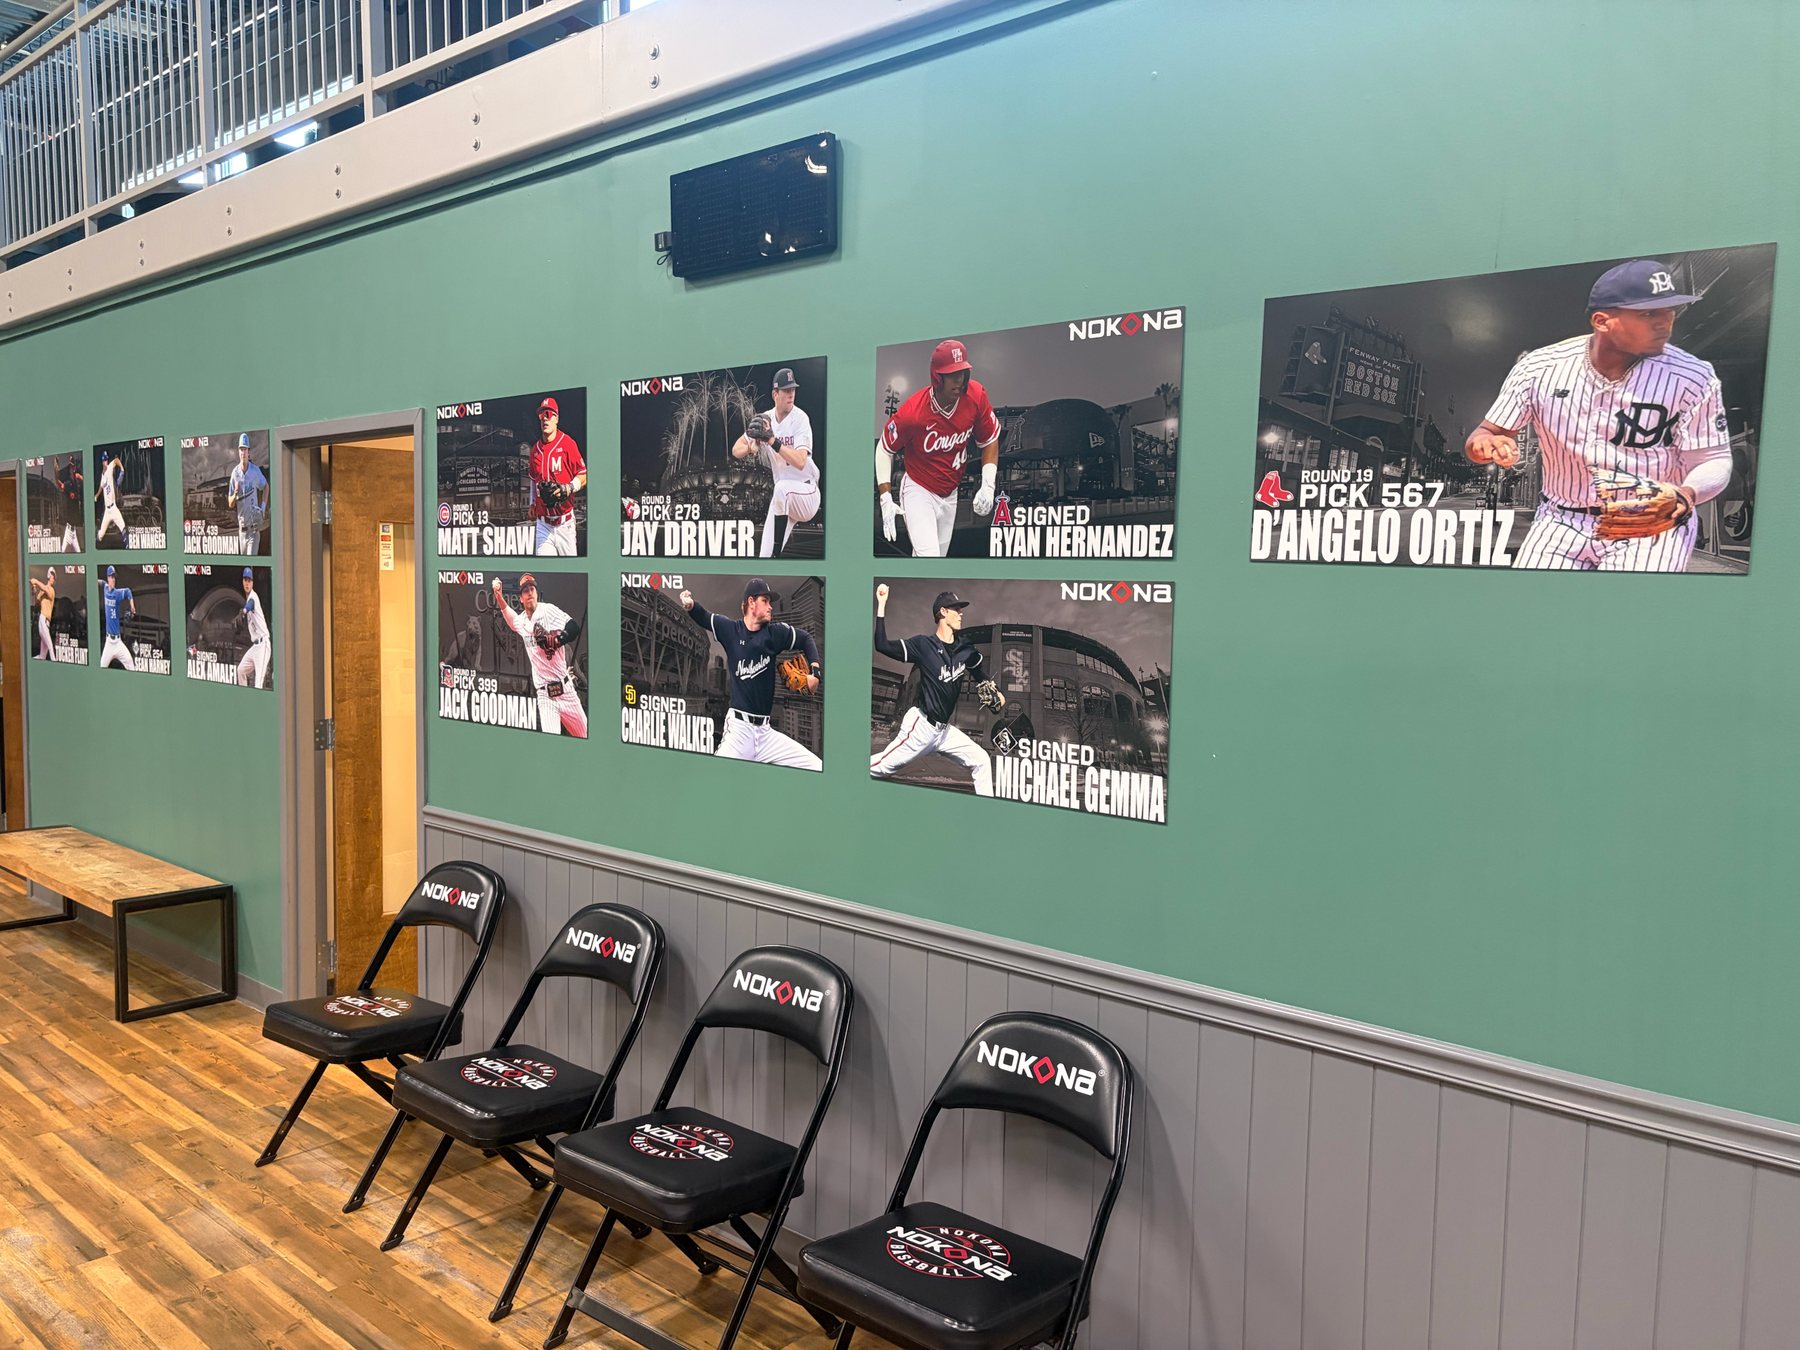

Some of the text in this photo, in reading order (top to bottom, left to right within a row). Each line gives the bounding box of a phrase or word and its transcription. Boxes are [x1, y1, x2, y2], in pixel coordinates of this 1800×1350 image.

[1069, 309, 1183, 341] NOKONA
[1349, 347, 1401, 371] FENWAY PARK
[621, 376, 683, 396] NOKONA
[1347, 362, 1399, 391] BOSTON
[1344, 378, 1397, 405] RED SOX
[437, 402, 482, 420] NOKONA
[1301, 469, 1373, 483] ROUND 19
[642, 496, 664, 504] ROUND
[1299, 482, 1444, 508] PICK 567
[453, 511, 474, 525] PICK
[477, 511, 488, 525] 13
[641, 504, 700, 521] PICK 278
[1013, 505, 1090, 526] SIGNED
[129, 533, 166, 549] BEN WANGER
[192, 526, 218, 535] PICK 439
[438, 526, 535, 555] MATT SHAW
[622, 520, 754, 557] JAY DRIVER
[989, 523, 1174, 558] RYAN HERNANDEZ
[1251, 508, 1515, 566] D'ANGELO ORTIZ
[184, 536, 239, 554] JACK GOODMAN
[438, 572, 484, 585] NOKONA
[621, 573, 683, 590] NOKONA
[1060, 581, 1173, 604] NOKONA
[197, 650, 217, 663] SIGNED
[187, 659, 237, 685] ALEX AMALFI
[454, 676, 498, 693] PICK 399
[440, 687, 537, 730] JACK GOODMAN
[640, 695, 686, 714] SIGNED
[621, 706, 715, 754] CHARLIE WALKER
[1018, 738, 1095, 767] SIGNED
[995, 755, 1165, 823] MICHAEL GEMMA
[421, 882, 480, 910] NOKONA
[566, 927, 637, 963] NOKONA
[733, 969, 823, 1012] NOKONA
[976, 1040, 1097, 1096] NOKONA
[890, 1244, 963, 1277] BASEBALL
